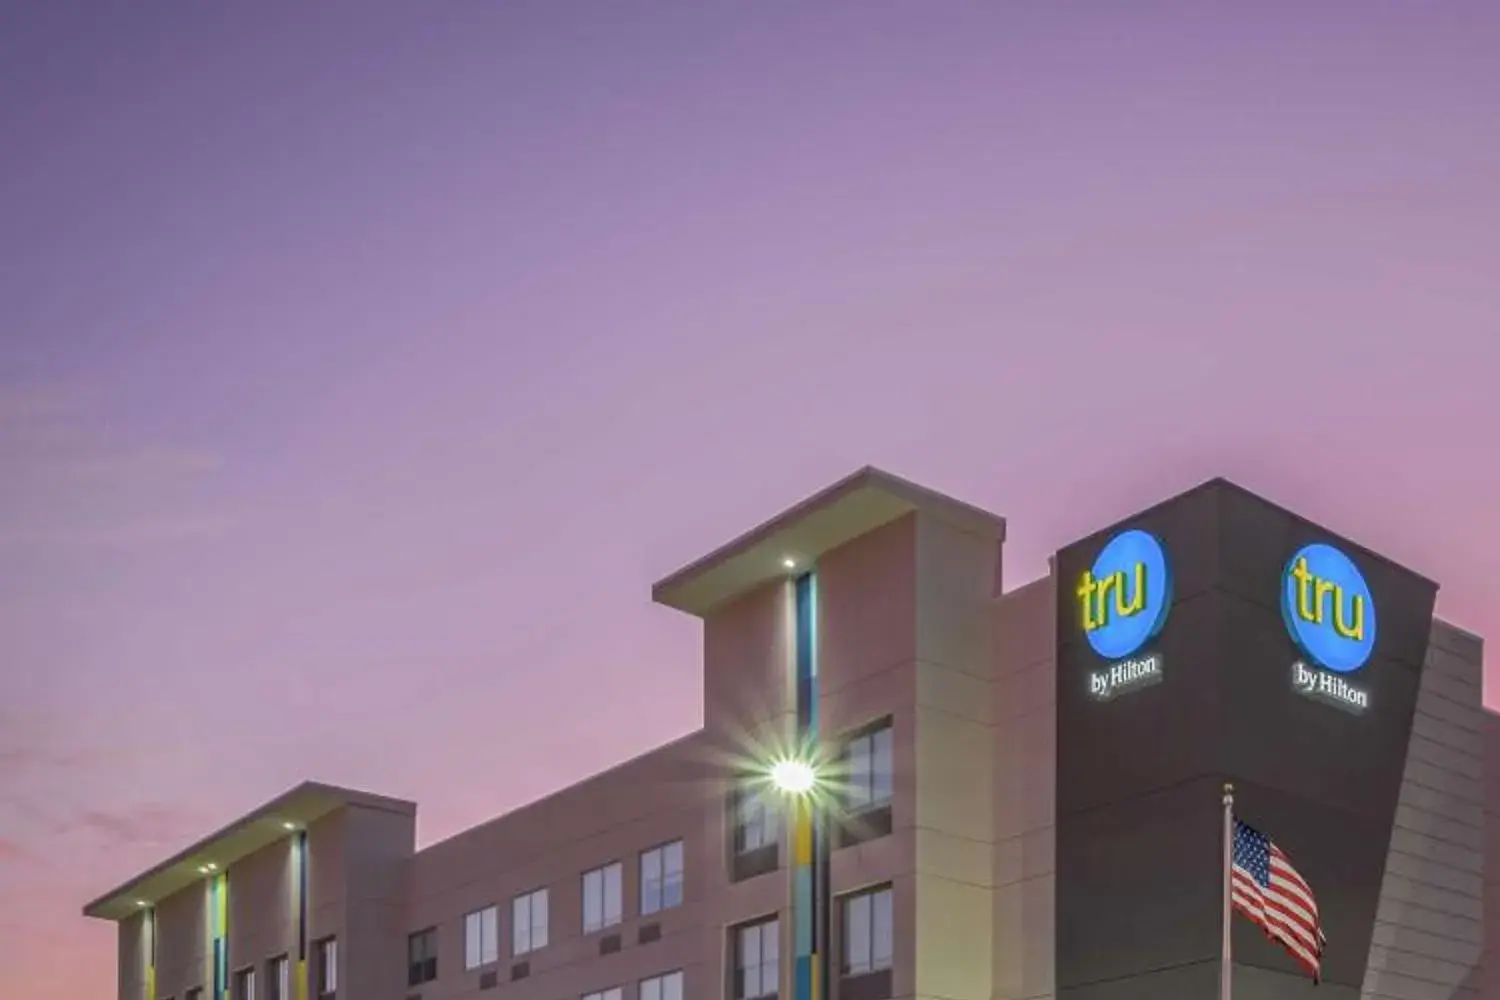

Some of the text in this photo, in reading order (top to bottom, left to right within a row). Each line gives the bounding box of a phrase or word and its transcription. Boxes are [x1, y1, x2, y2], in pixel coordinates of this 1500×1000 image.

[1077, 562, 1145, 631] tru
[1292, 557, 1364, 640] tru
[1091, 655, 1156, 695] by Hilton
[1298, 664, 1368, 707] by Hilton
